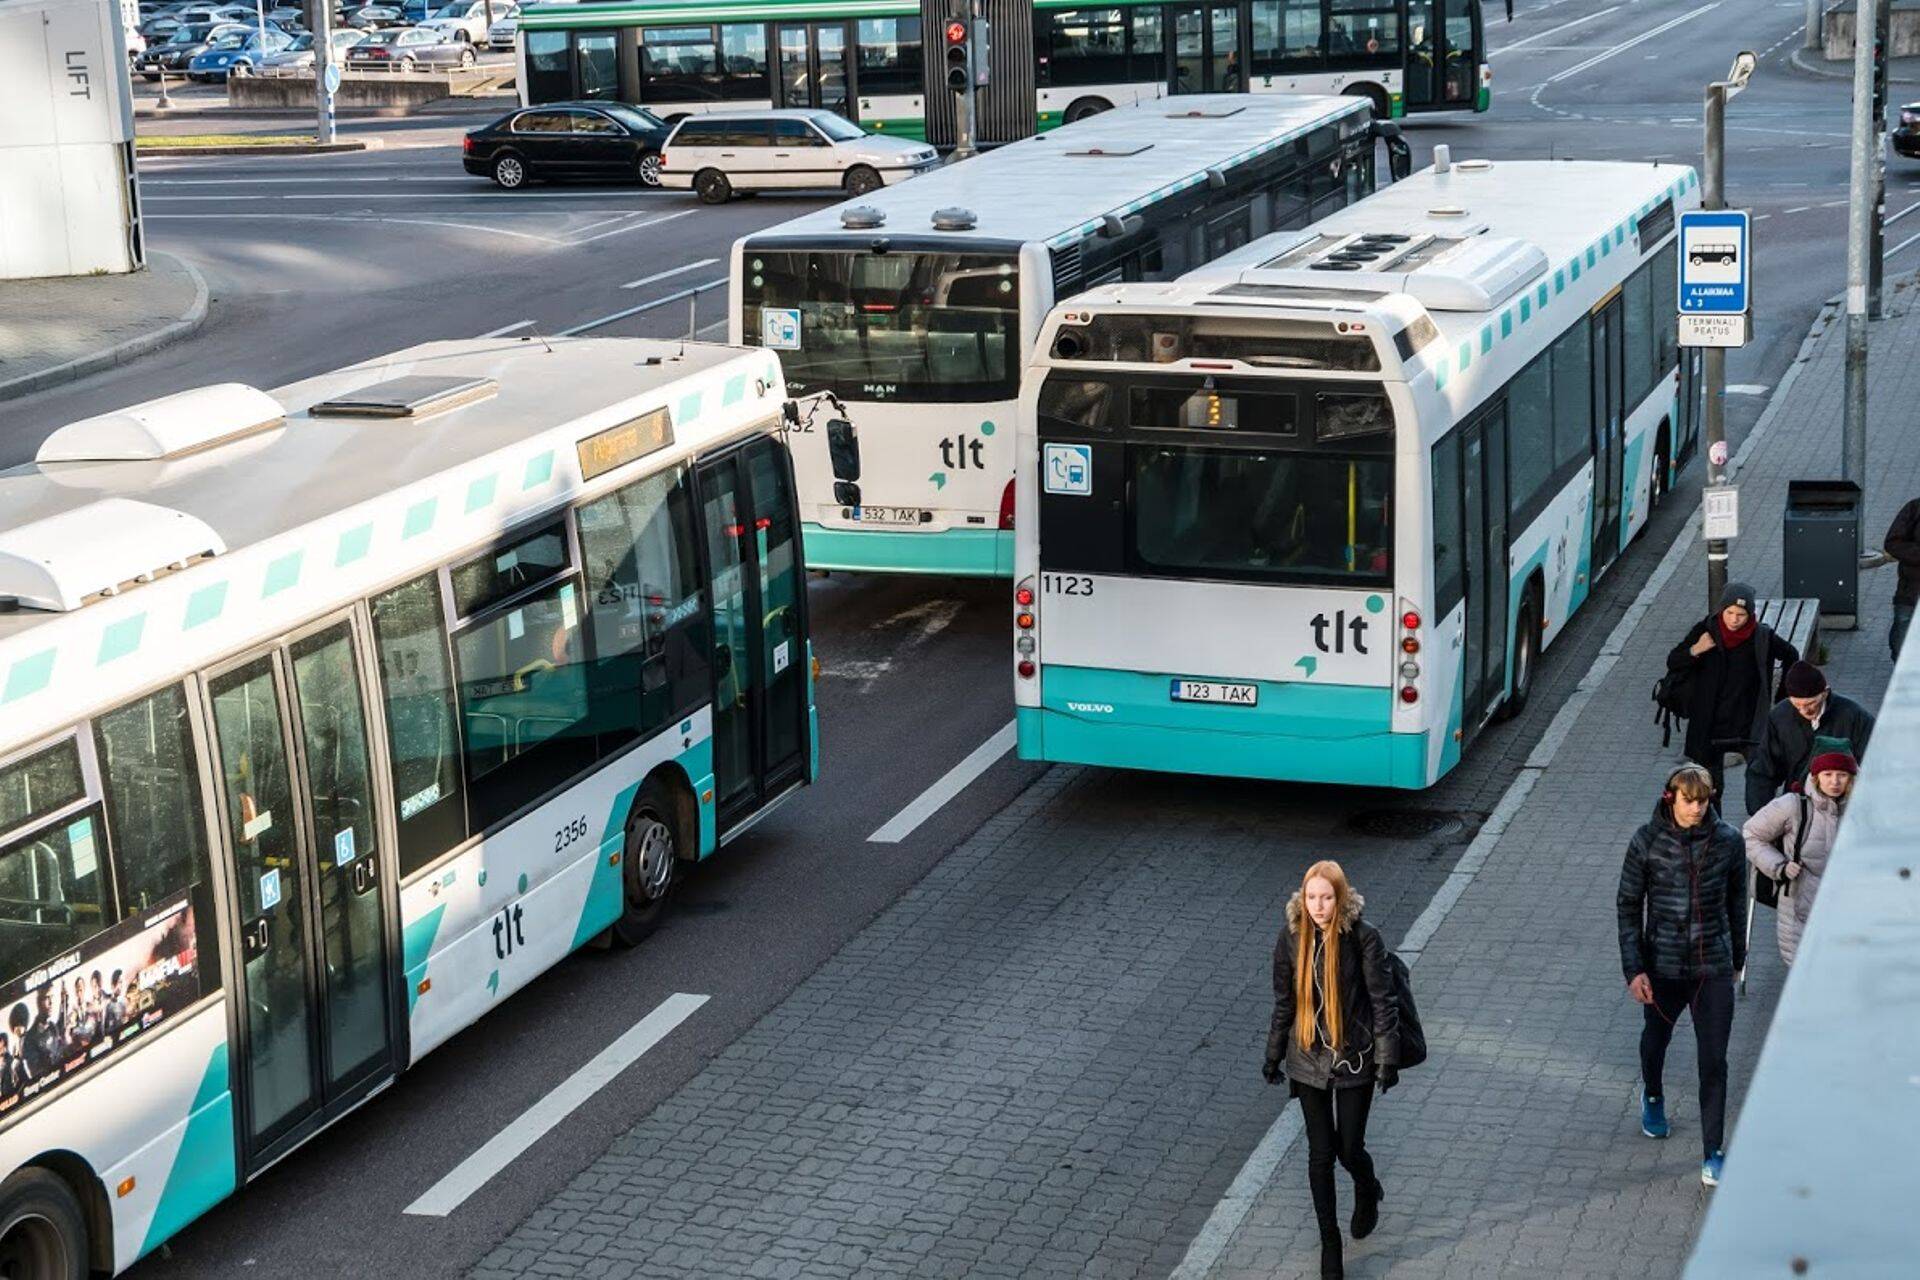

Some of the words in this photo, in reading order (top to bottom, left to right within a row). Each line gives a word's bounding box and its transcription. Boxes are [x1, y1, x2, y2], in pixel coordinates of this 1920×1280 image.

[66, 51, 90, 100] LIFT
[1685, 299, 1692, 307] A
[1688, 318, 1736, 326] TERMINALI
[1693, 327, 1730, 335] PEATUS
[863, 384, 896, 393] MAN
[939, 433, 985, 469] tlt
[864, 508, 886, 520] 532
[892, 508, 916, 521] TAK
[1043, 575, 1094, 597] 1123
[1309, 609, 1369, 655] tlt
[1187, 684, 1210, 699] 123
[1221, 685, 1252, 702] TAK
[1067, 702, 1114, 713] VOLVO
[555, 815, 587, 853] 2356
[493, 904, 525, 959] tlt
